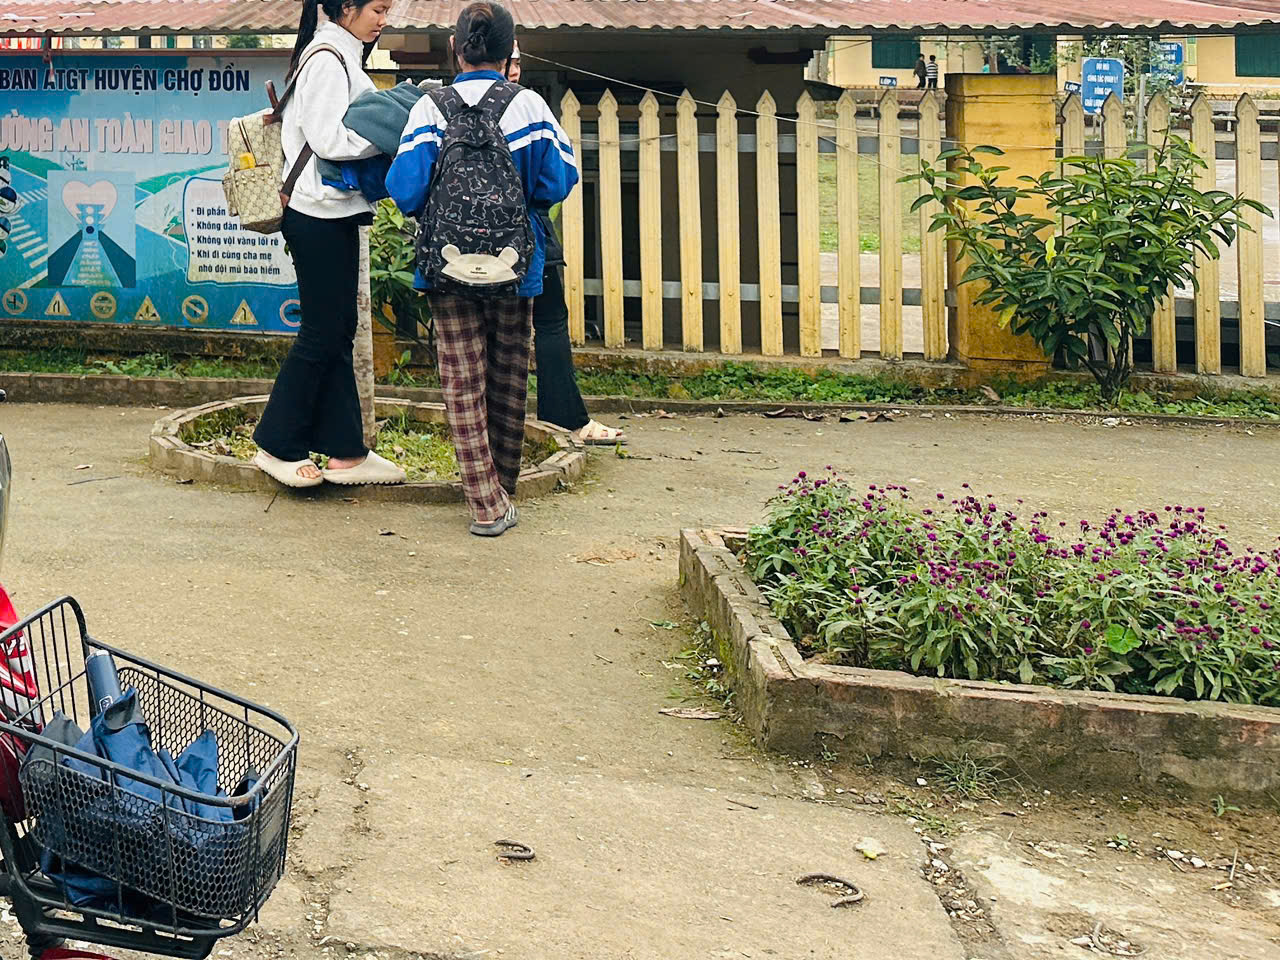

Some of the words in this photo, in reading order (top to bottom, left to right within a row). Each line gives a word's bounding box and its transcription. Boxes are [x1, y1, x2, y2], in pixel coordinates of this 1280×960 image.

[43, 69, 89, 90] ATGT
[94, 65, 157, 95] HUYỆN
[164, 68, 204, 96] CHỢ
[208, 62, 250, 91] ĐỒN
[58, 117, 90, 152] AN
[95, 112, 153, 154] TOÀN
[159, 119, 213, 155] GIAO
[196, 207, 205, 216] Đi
[196, 221, 221, 231] Không
[196, 235, 222, 245] Không
[237, 236, 256, 247] vàng
[196, 249, 210, 259] Khi
[212, 250, 220, 259] đi
[221, 250, 241, 261] cùng
[243, 251, 257, 260] cha
[215, 264, 227, 275] đội
